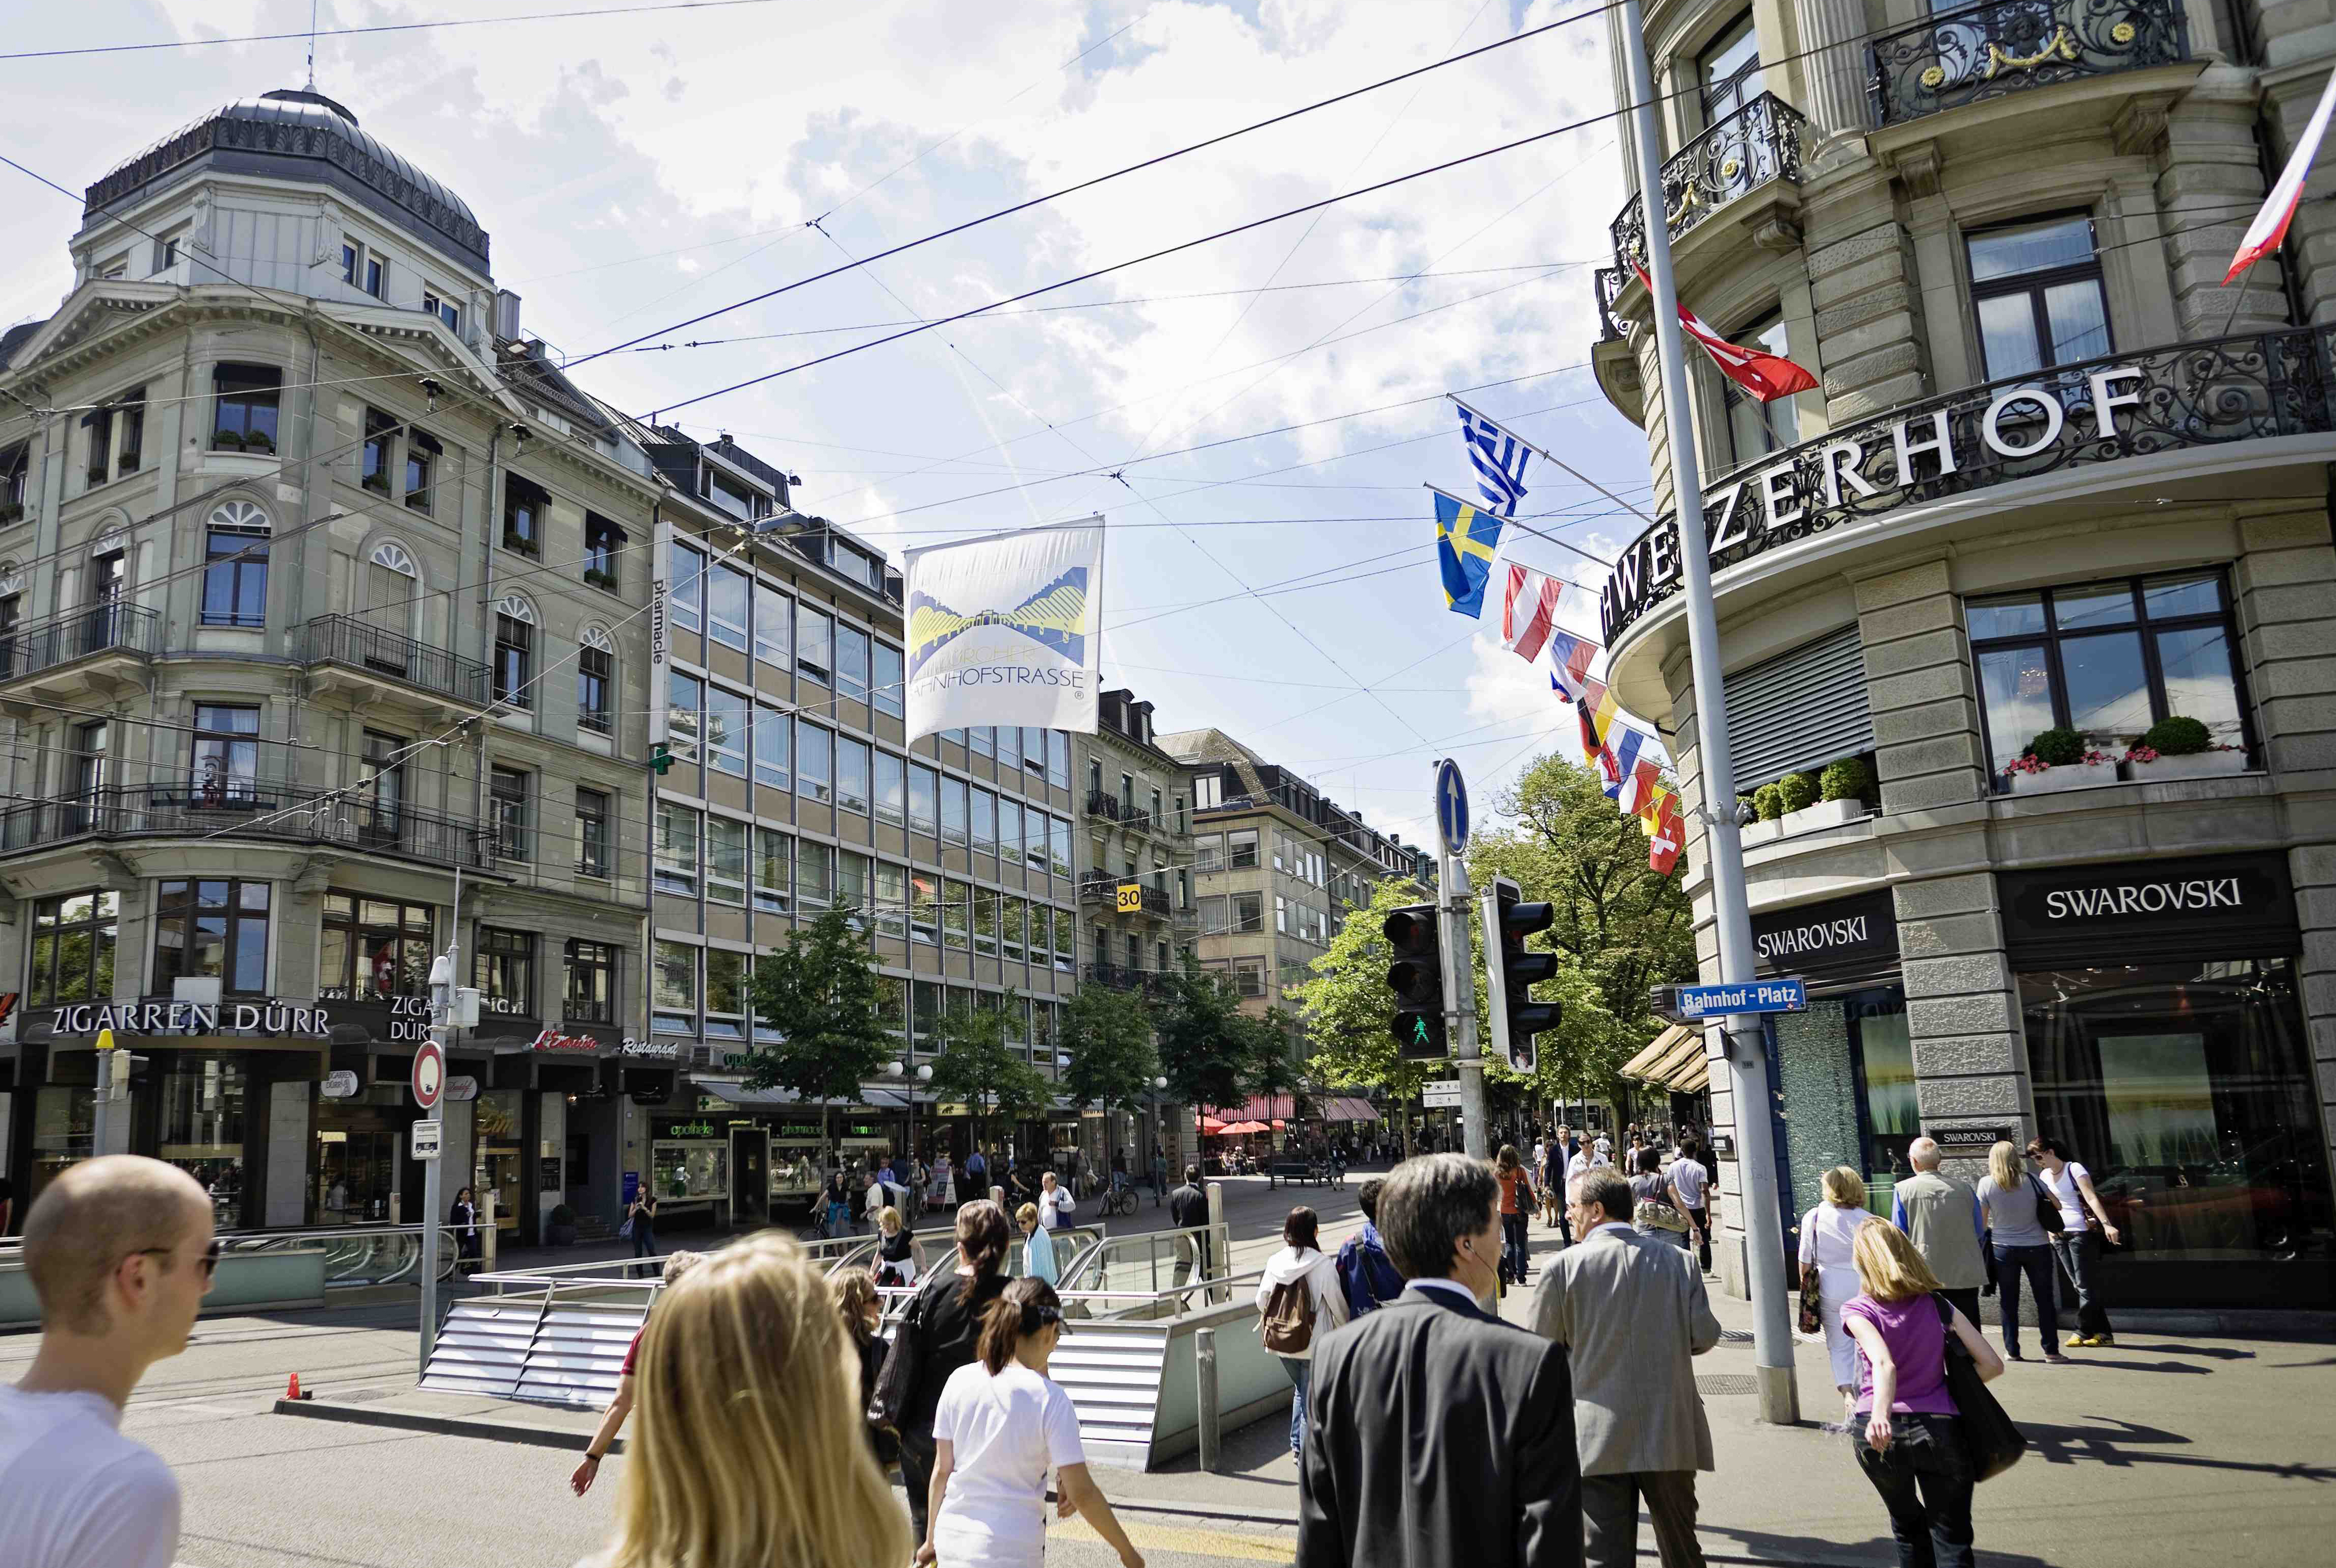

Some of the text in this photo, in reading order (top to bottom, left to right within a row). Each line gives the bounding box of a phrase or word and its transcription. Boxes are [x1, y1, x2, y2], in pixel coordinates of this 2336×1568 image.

[653, 580, 666, 664] pharmacie
[1119, 891, 1139, 906] 30
[2046, 878, 2243, 918] SWAROVSKI
[1758, 916, 1868, 958] SWAROVSKI
[52, 1004, 216, 1034] ZIGARREN
[235, 1000, 330, 1034] DÜRR
[391, 996, 432, 1016] ZIGA
[391, 1018, 429, 1040] DÜR
[622, 1037, 678, 1054] Restaurant
[1943, 1132, 1996, 1142] SWAROVSKI
